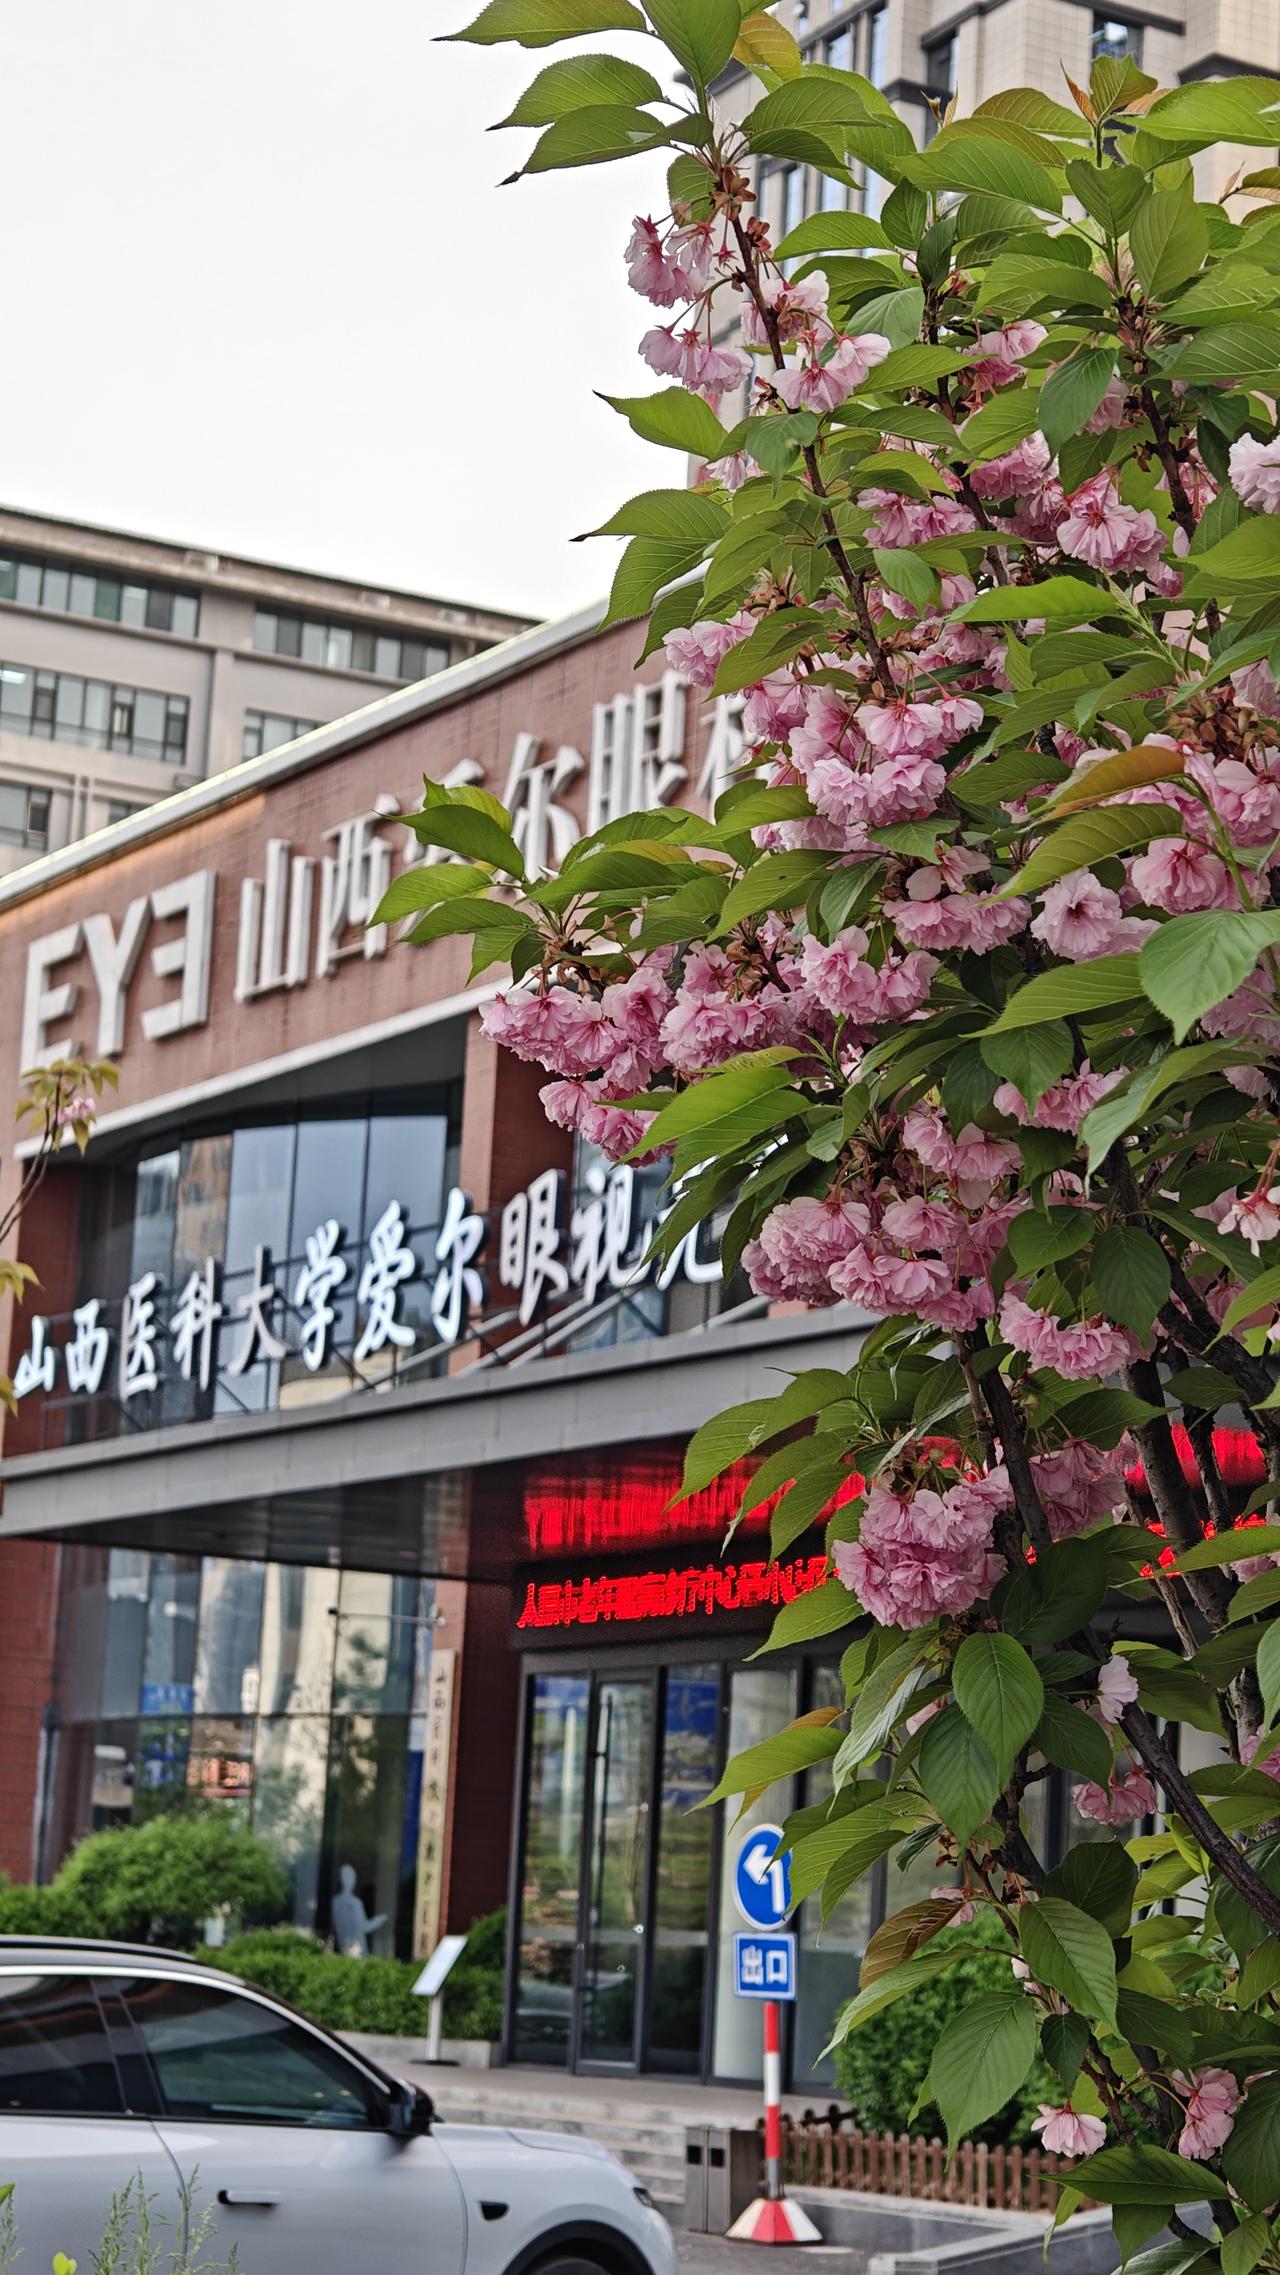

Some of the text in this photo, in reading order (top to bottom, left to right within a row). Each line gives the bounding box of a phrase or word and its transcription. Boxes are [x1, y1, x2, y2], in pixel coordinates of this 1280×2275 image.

[235, 668, 765, 1004] 山西尔眼
[741, 1944, 787, 1985] 出口
